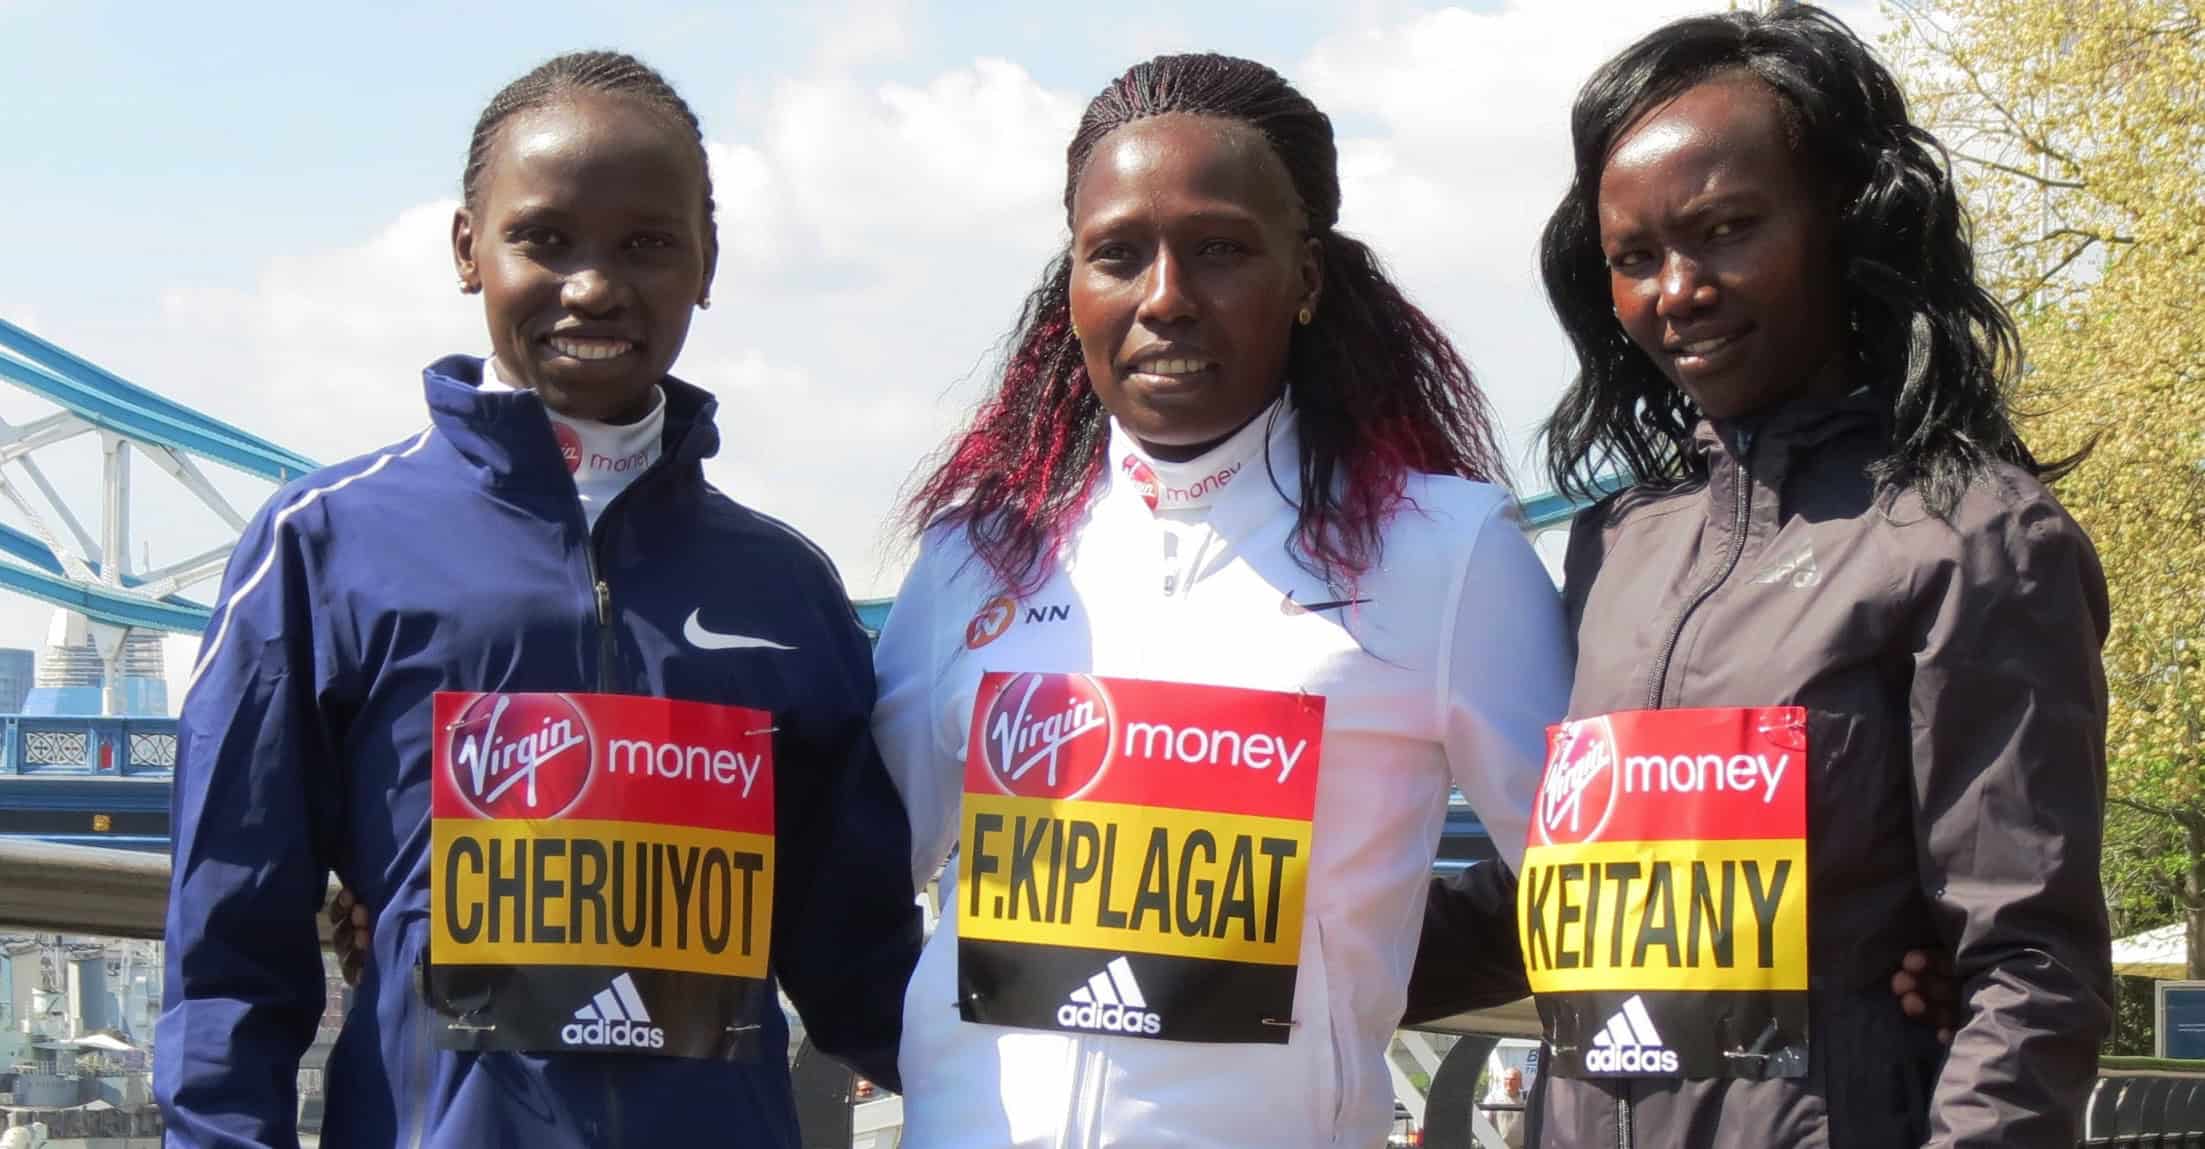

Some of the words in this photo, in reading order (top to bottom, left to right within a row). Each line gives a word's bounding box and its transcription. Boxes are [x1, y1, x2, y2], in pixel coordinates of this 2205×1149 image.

[1026, 605, 1071, 624] NN
[459, 695, 584, 807] Virgin
[608, 738, 761, 799] money
[992, 674, 1105, 786] Virgin
[1124, 721, 1307, 784] money
[1545, 721, 1611, 832] Virgin
[1624, 754, 1789, 803] money
[445, 836, 764, 957] CHERUIYOT
[969, 813, 1299, 944] F.KIPLAGAT
[1527, 859, 1793, 972] KEITANY
[560, 1020, 665, 1048] adidas
[1057, 1001, 1162, 1035] adidas
[1585, 1042, 1679, 1073] adidas
